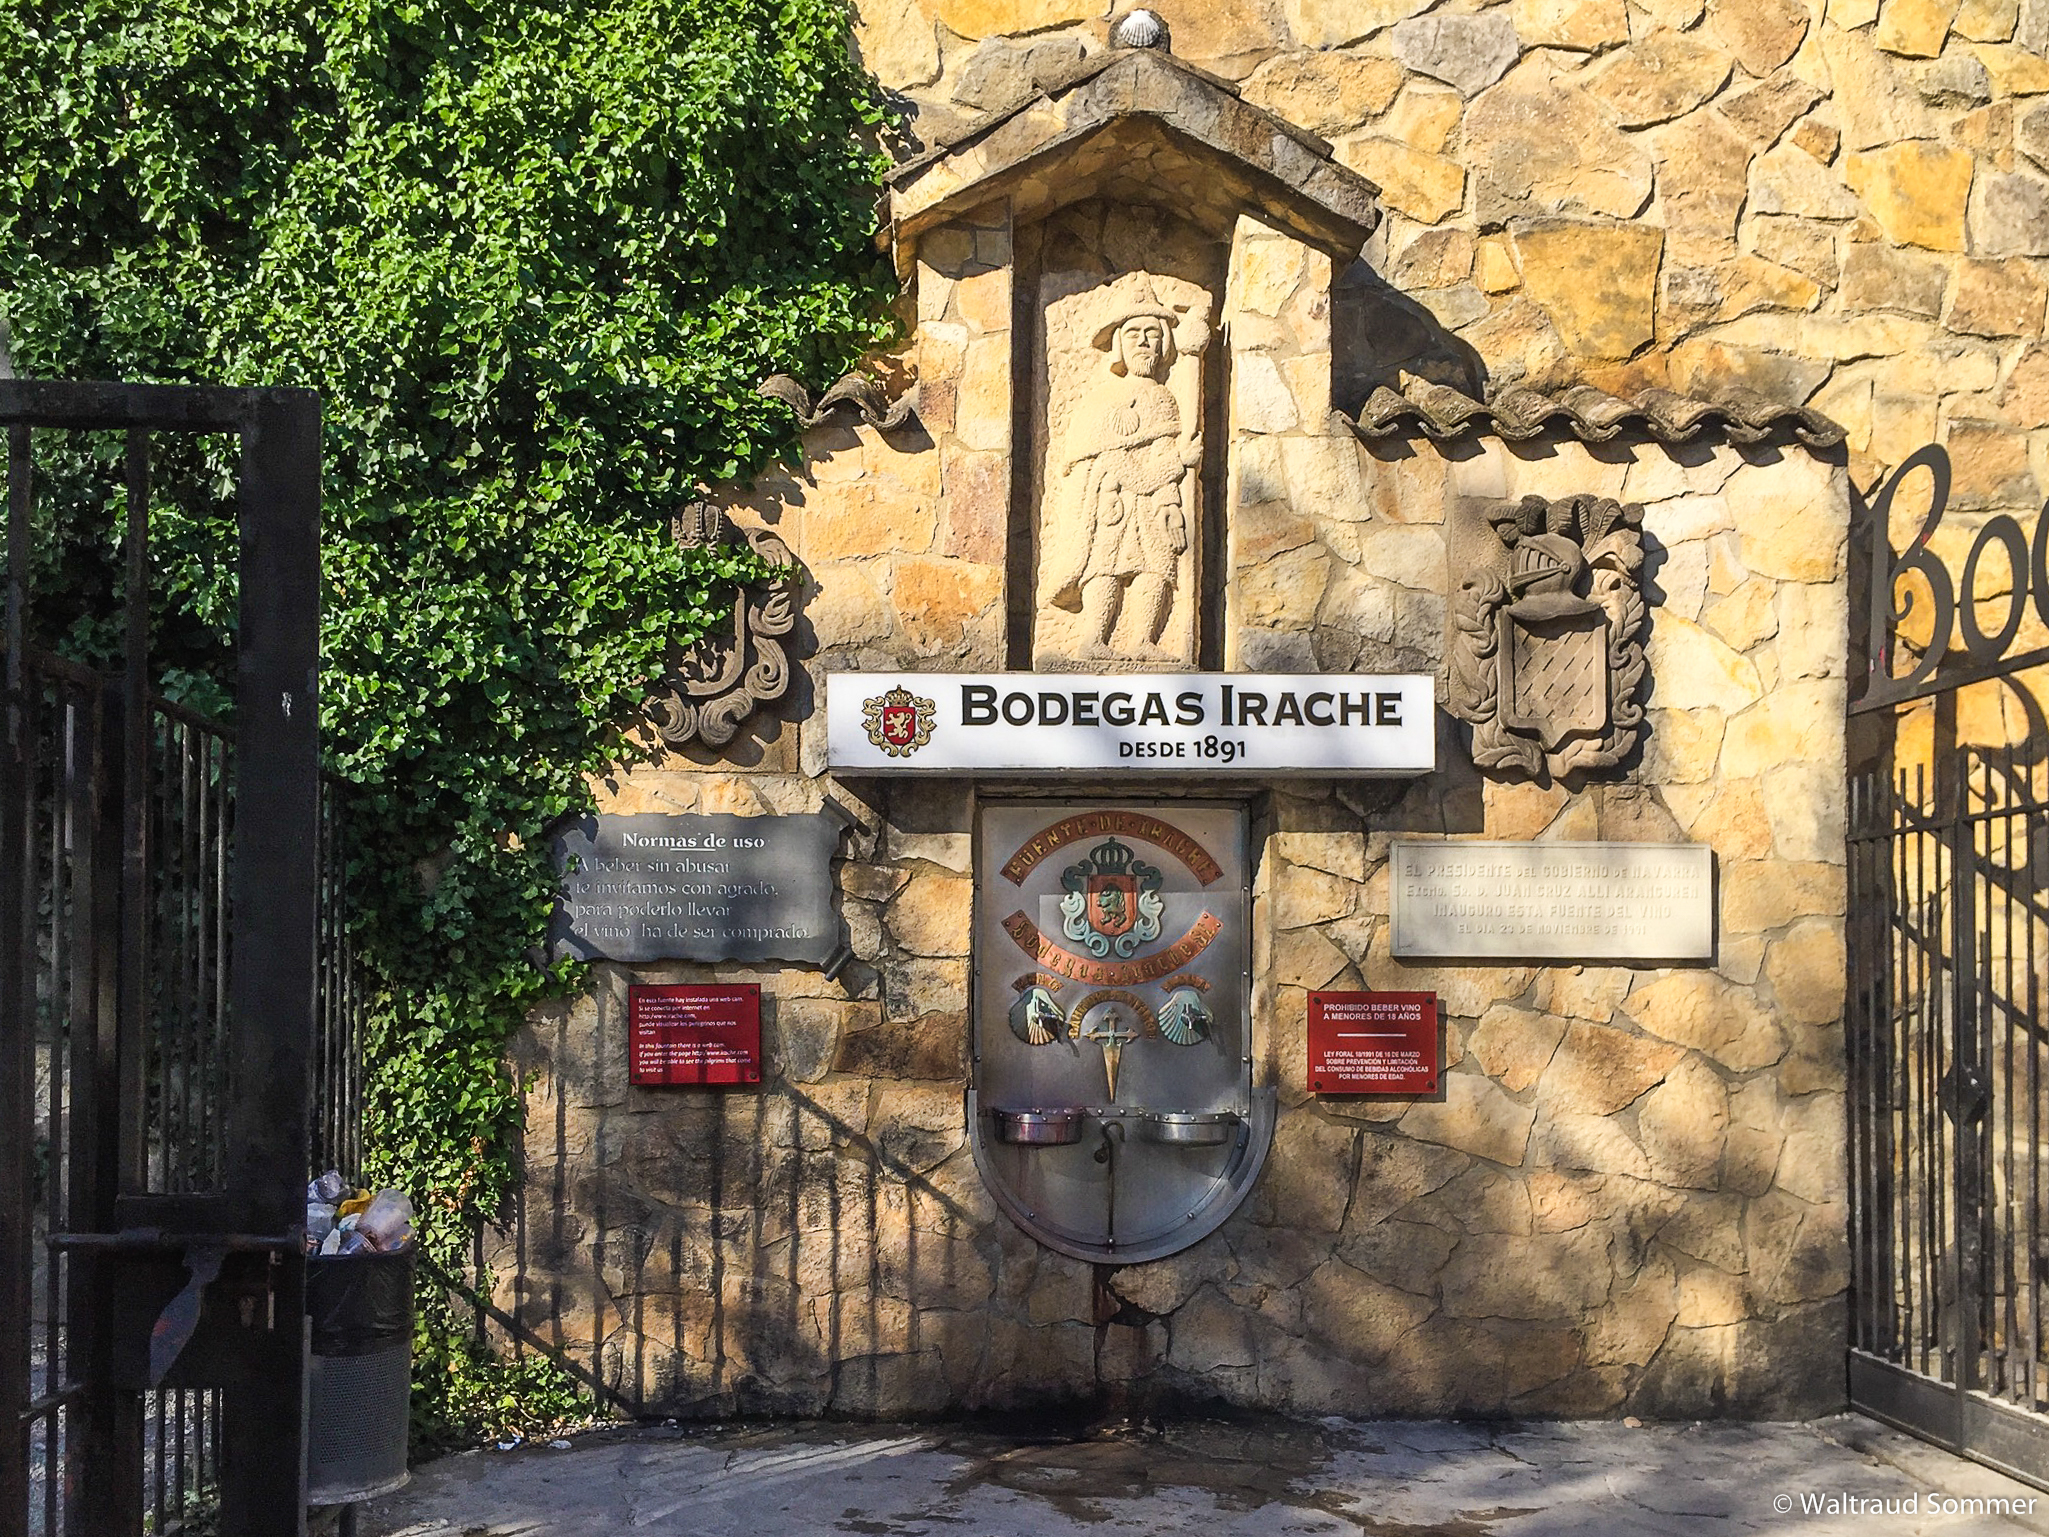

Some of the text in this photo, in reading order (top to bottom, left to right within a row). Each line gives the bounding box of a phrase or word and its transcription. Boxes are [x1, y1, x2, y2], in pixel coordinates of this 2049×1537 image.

[960, 685, 1402, 726] BODEGAS IRACHE
[1120, 736, 1246, 762] DESDE 1891
[1099, 815, 1127, 832] DE
[622, 833, 765, 848] Normas de uso
[595, 858, 640, 872] beber
[648, 858, 669, 872] sin
[676, 858, 730, 872] abusar
[1405, 865, 1699, 877] EL PRESIDENTE DEL GOBIERNO DE NAVARRA
[576, 882, 586, 895] te
[595, 881, 676, 895] invitamos
[682, 884, 712, 895] con
[1496, 885, 1531, 897] JUAN
[1537, 885, 1570, 897] CRUZ
[1577, 885, 1610, 897] ALLI
[1615, 885, 1698, 897] ARANGUREN
[575, 902, 732, 920] para poderlo llevar
[1507, 905, 1542, 917] ESTA
[1549, 905, 1601, 917] FUENTE
[1608, 905, 1632, 917] DEL
[1639, 905, 1671, 917] VINO
[574, 924, 588, 938] el
[595, 924, 630, 938] vino
[642, 924, 661, 938] ha
[667, 924, 687, 938] de
[693, 928, 715, 938] ser
[1458, 924, 1471, 934] EL
[1519, 924, 1533, 934] DE
[1537, 924, 1599, 934] NOVIEMBRE
[1605, 924, 1618, 934] DE
[1398, 1012, 1421, 1020] AÑOS
